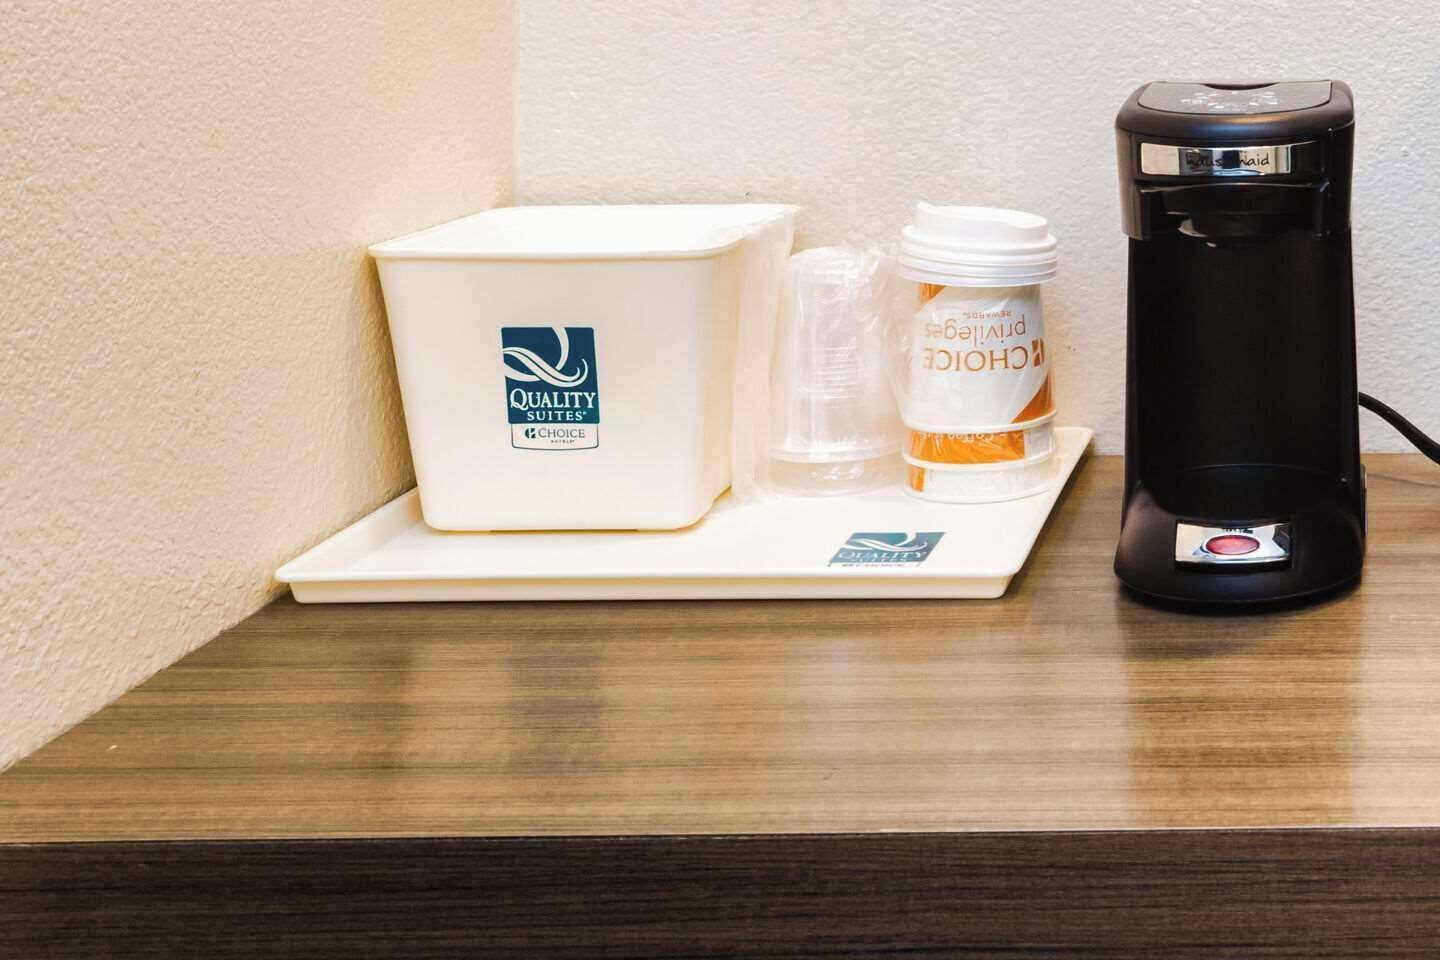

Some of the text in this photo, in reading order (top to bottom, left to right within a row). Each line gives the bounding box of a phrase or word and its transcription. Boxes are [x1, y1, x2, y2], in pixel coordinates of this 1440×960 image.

[925, 314, 1027, 347] privileges
[923, 345, 1029, 372] CHOICE
[510, 388, 596, 411] QUALITY
[527, 411, 583, 421] SUITES
[538, 427, 586, 439] CHOICE
